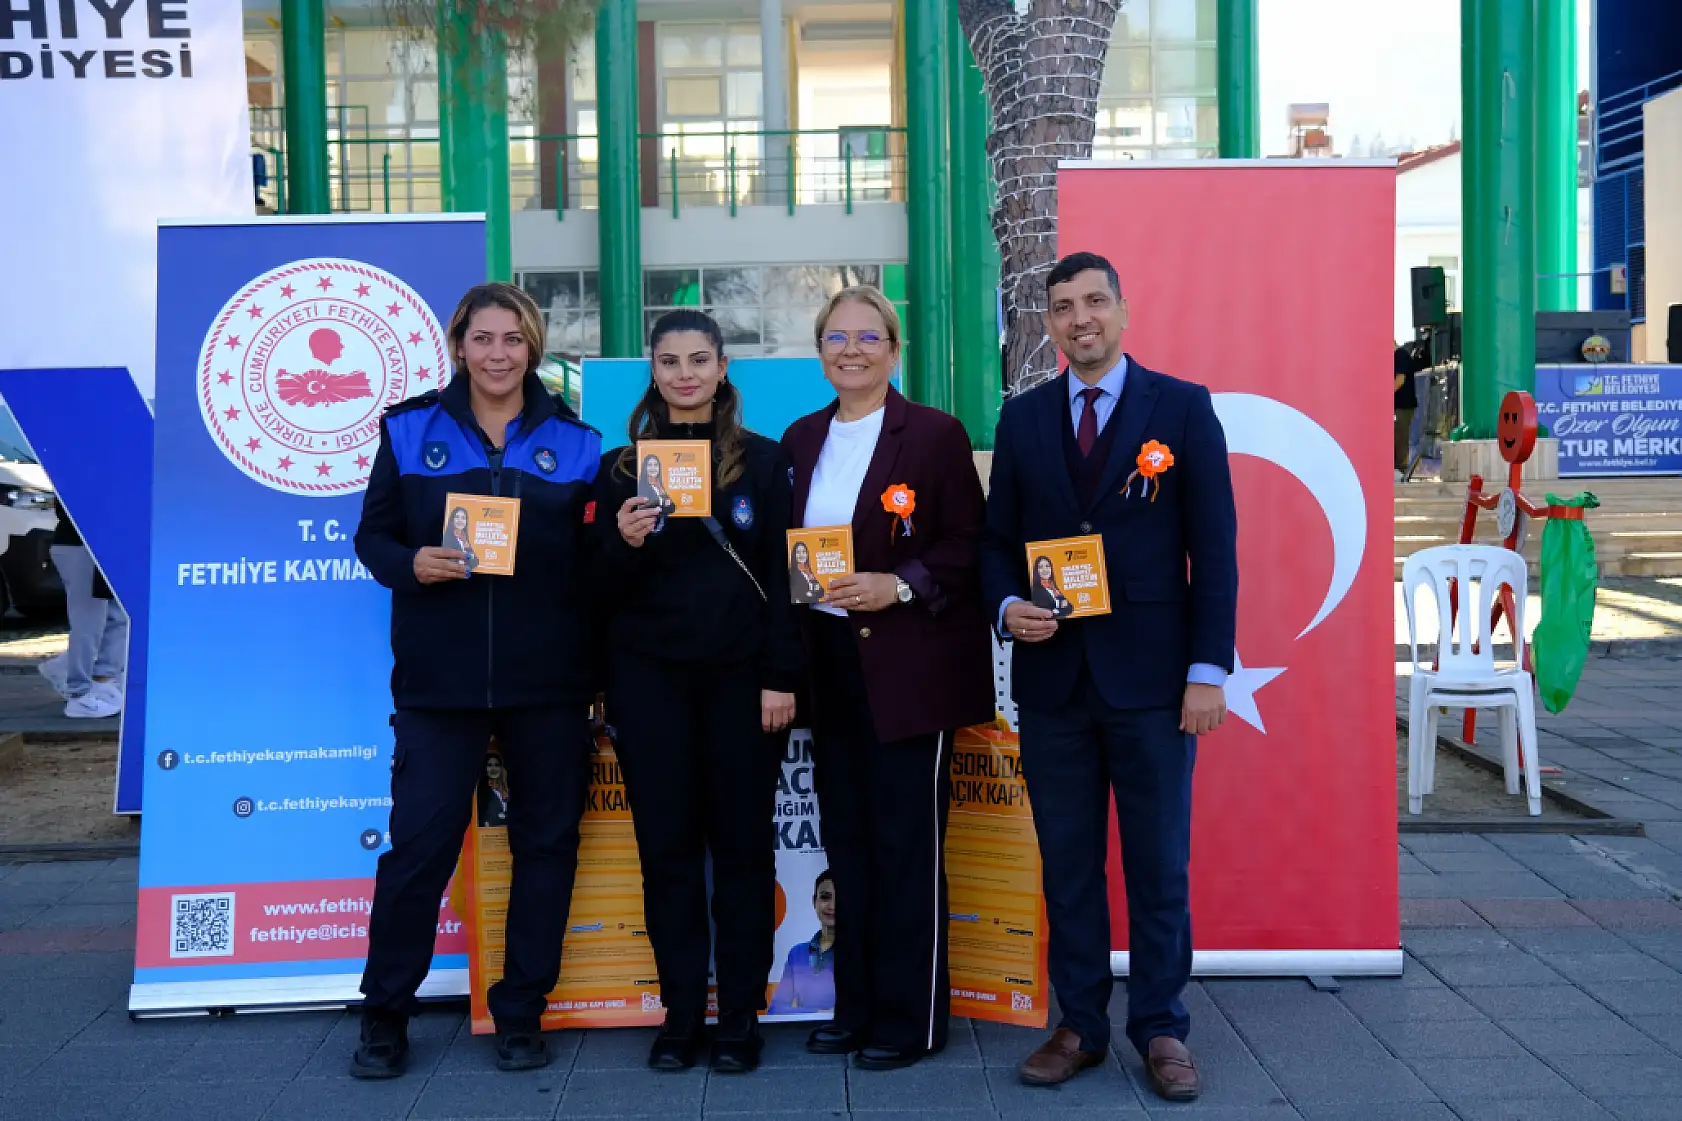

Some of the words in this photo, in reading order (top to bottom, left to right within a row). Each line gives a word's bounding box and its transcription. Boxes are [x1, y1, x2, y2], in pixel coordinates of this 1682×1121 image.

[1, 43, 193, 79] DİYESİ
[249, 302, 318, 393] CUMHURİYETİ
[327, 304, 391, 345] FETHİYE
[1611, 412, 1680, 439] Olgun
[1613, 437, 1682, 457] MERK
[177, 557, 277, 585] FETHİYE
[284, 558, 375, 582] KAYMA
[184, 744, 378, 765] t.c.fethiyekaymakamligi
[257, 794, 393, 812] t.c.fethiyekayma
